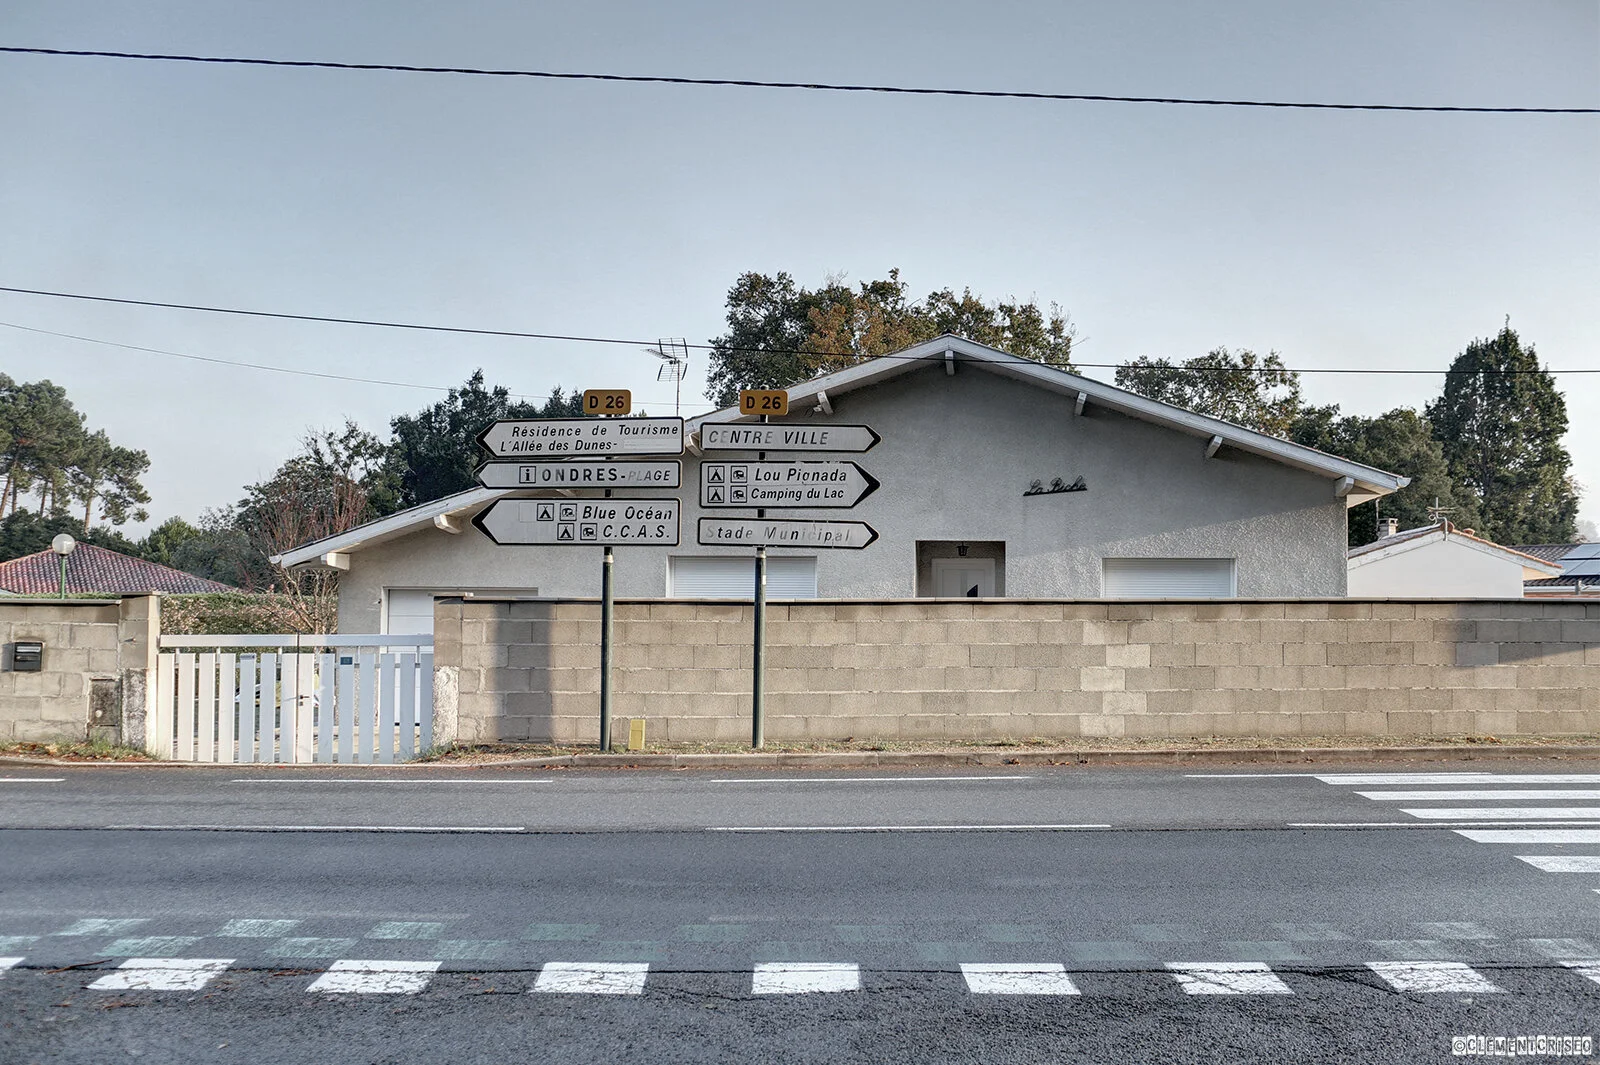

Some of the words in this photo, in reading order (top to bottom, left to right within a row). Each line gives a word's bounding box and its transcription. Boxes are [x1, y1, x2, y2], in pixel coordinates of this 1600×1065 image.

[589, 396, 599, 409] D
[605, 396, 625, 409] 26
[746, 397, 755, 409] D
[761, 397, 781, 409] 26
[512, 425, 582, 437] Résidence
[591, 424, 607, 436] de
[618, 424, 679, 436] Tourisme
[708, 431, 774, 444] CENTRE
[784, 431, 829, 445] VILLE
[548, 441, 569, 451] des
[754, 468, 781, 481] Lou
[751, 488, 803, 501] Camping
[806, 488, 821, 499] du
[824, 488, 844, 499] Lac
[582, 506, 616, 520] Blue
[624, 506, 672, 520] Océan
[603, 525, 670, 538] C.C.A.S.
[706, 526, 753, 539] Stade
